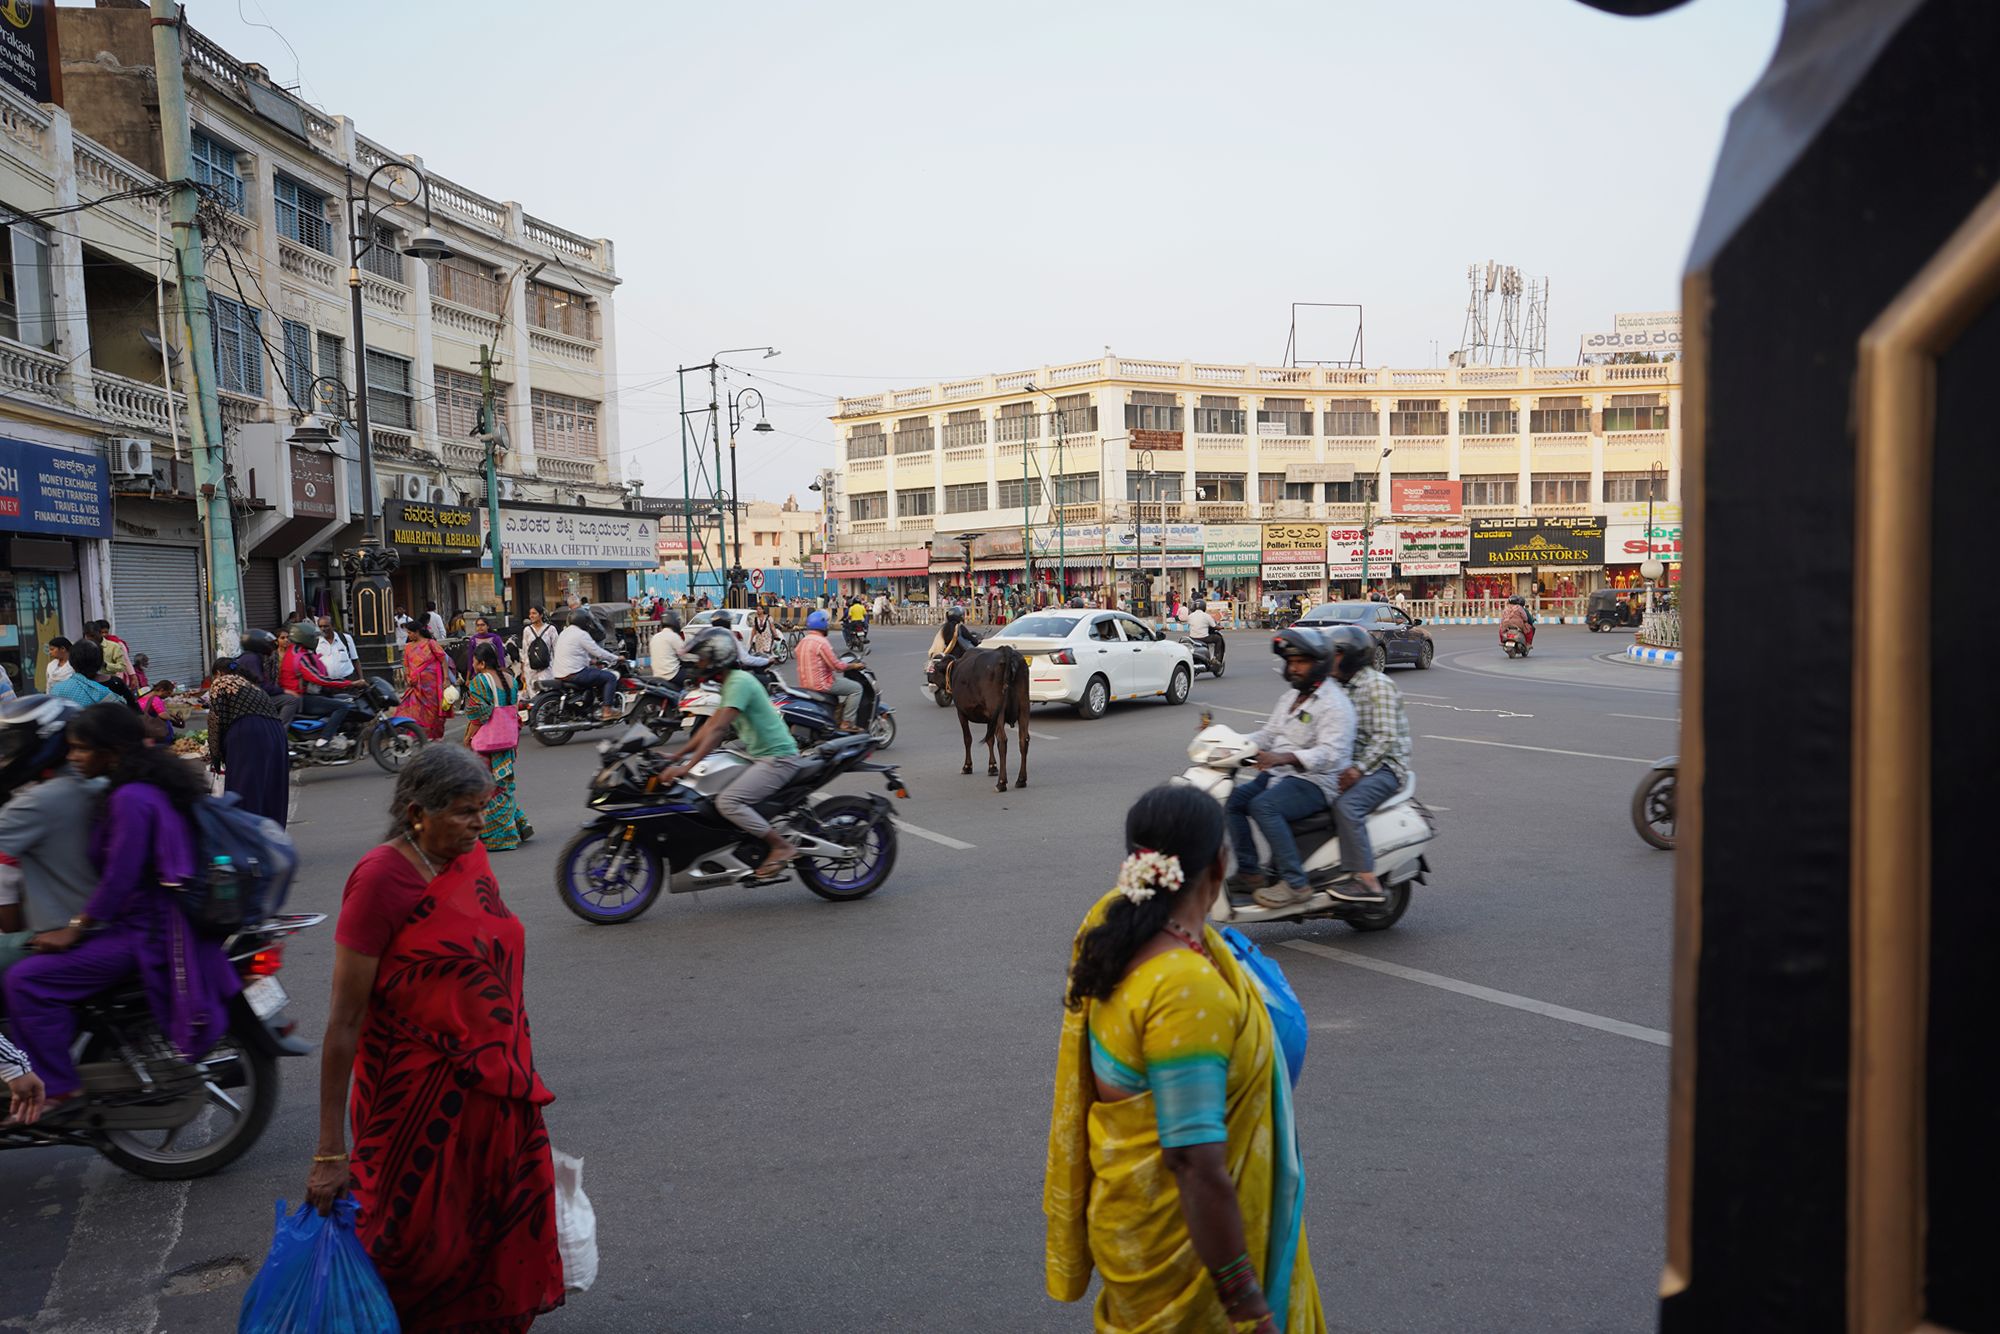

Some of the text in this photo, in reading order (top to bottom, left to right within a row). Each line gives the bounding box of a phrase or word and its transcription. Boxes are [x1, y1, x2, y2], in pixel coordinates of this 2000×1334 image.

[39, 473, 98, 491] MONEY EXCHANGE
[41, 486, 98, 503] MONEY TRANSFER
[54, 500, 99, 515] TRAVEL & VISA
[34, 511, 101, 527] FINANCIAL SERVICES
[394, 529, 480, 547] NAVARATNA ABHARAN
[1268, 527, 1321, 540] ಪಲ್ಲವಿ
[561, 544, 599, 556] CHETTY
[601, 545, 651, 557] JEWELLERS
[1206, 553, 1259, 562] MATCHING CENTRE
[1489, 550, 1589, 561] BADSHA STORES
[1206, 567, 1236, 575] MATCHING
